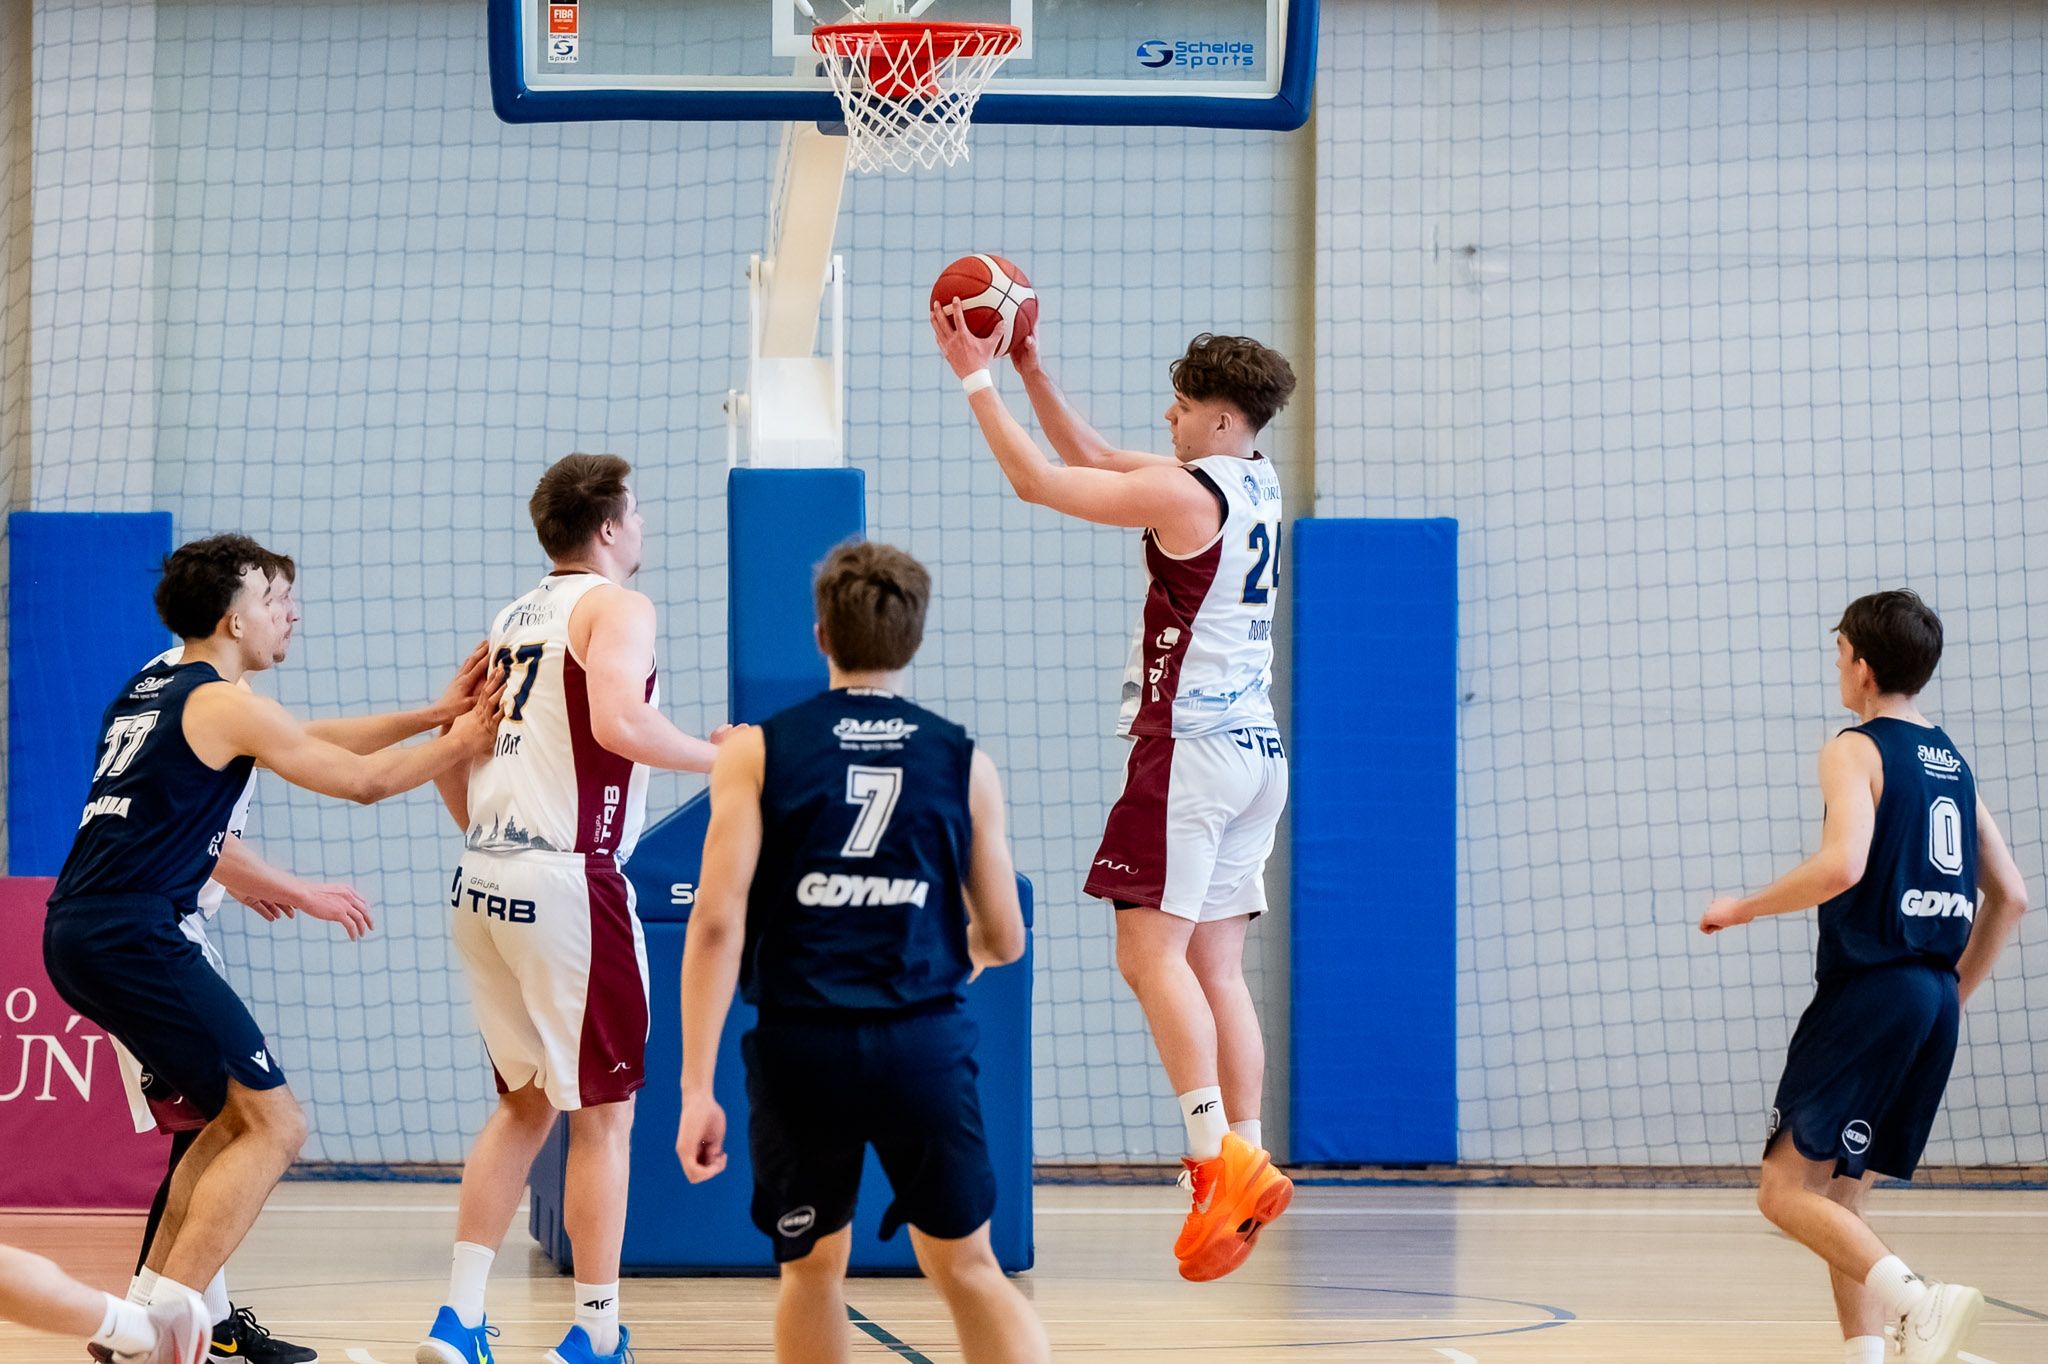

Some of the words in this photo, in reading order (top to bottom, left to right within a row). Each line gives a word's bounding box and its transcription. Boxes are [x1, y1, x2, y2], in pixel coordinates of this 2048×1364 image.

[554, 9, 573, 19] FIBA
[1175, 41, 1253, 54] Schelde
[1175, 54, 1253, 69] Sports
[600, 785, 620, 844] TRB
[841, 764, 903, 858] 7
[1929, 796, 1963, 876] 0
[470, 877, 500, 891] GRUPA
[797, 872, 929, 909] GDYNIA
[467, 888, 536, 924] TRB
[1901, 888, 1974, 923] GDYN
